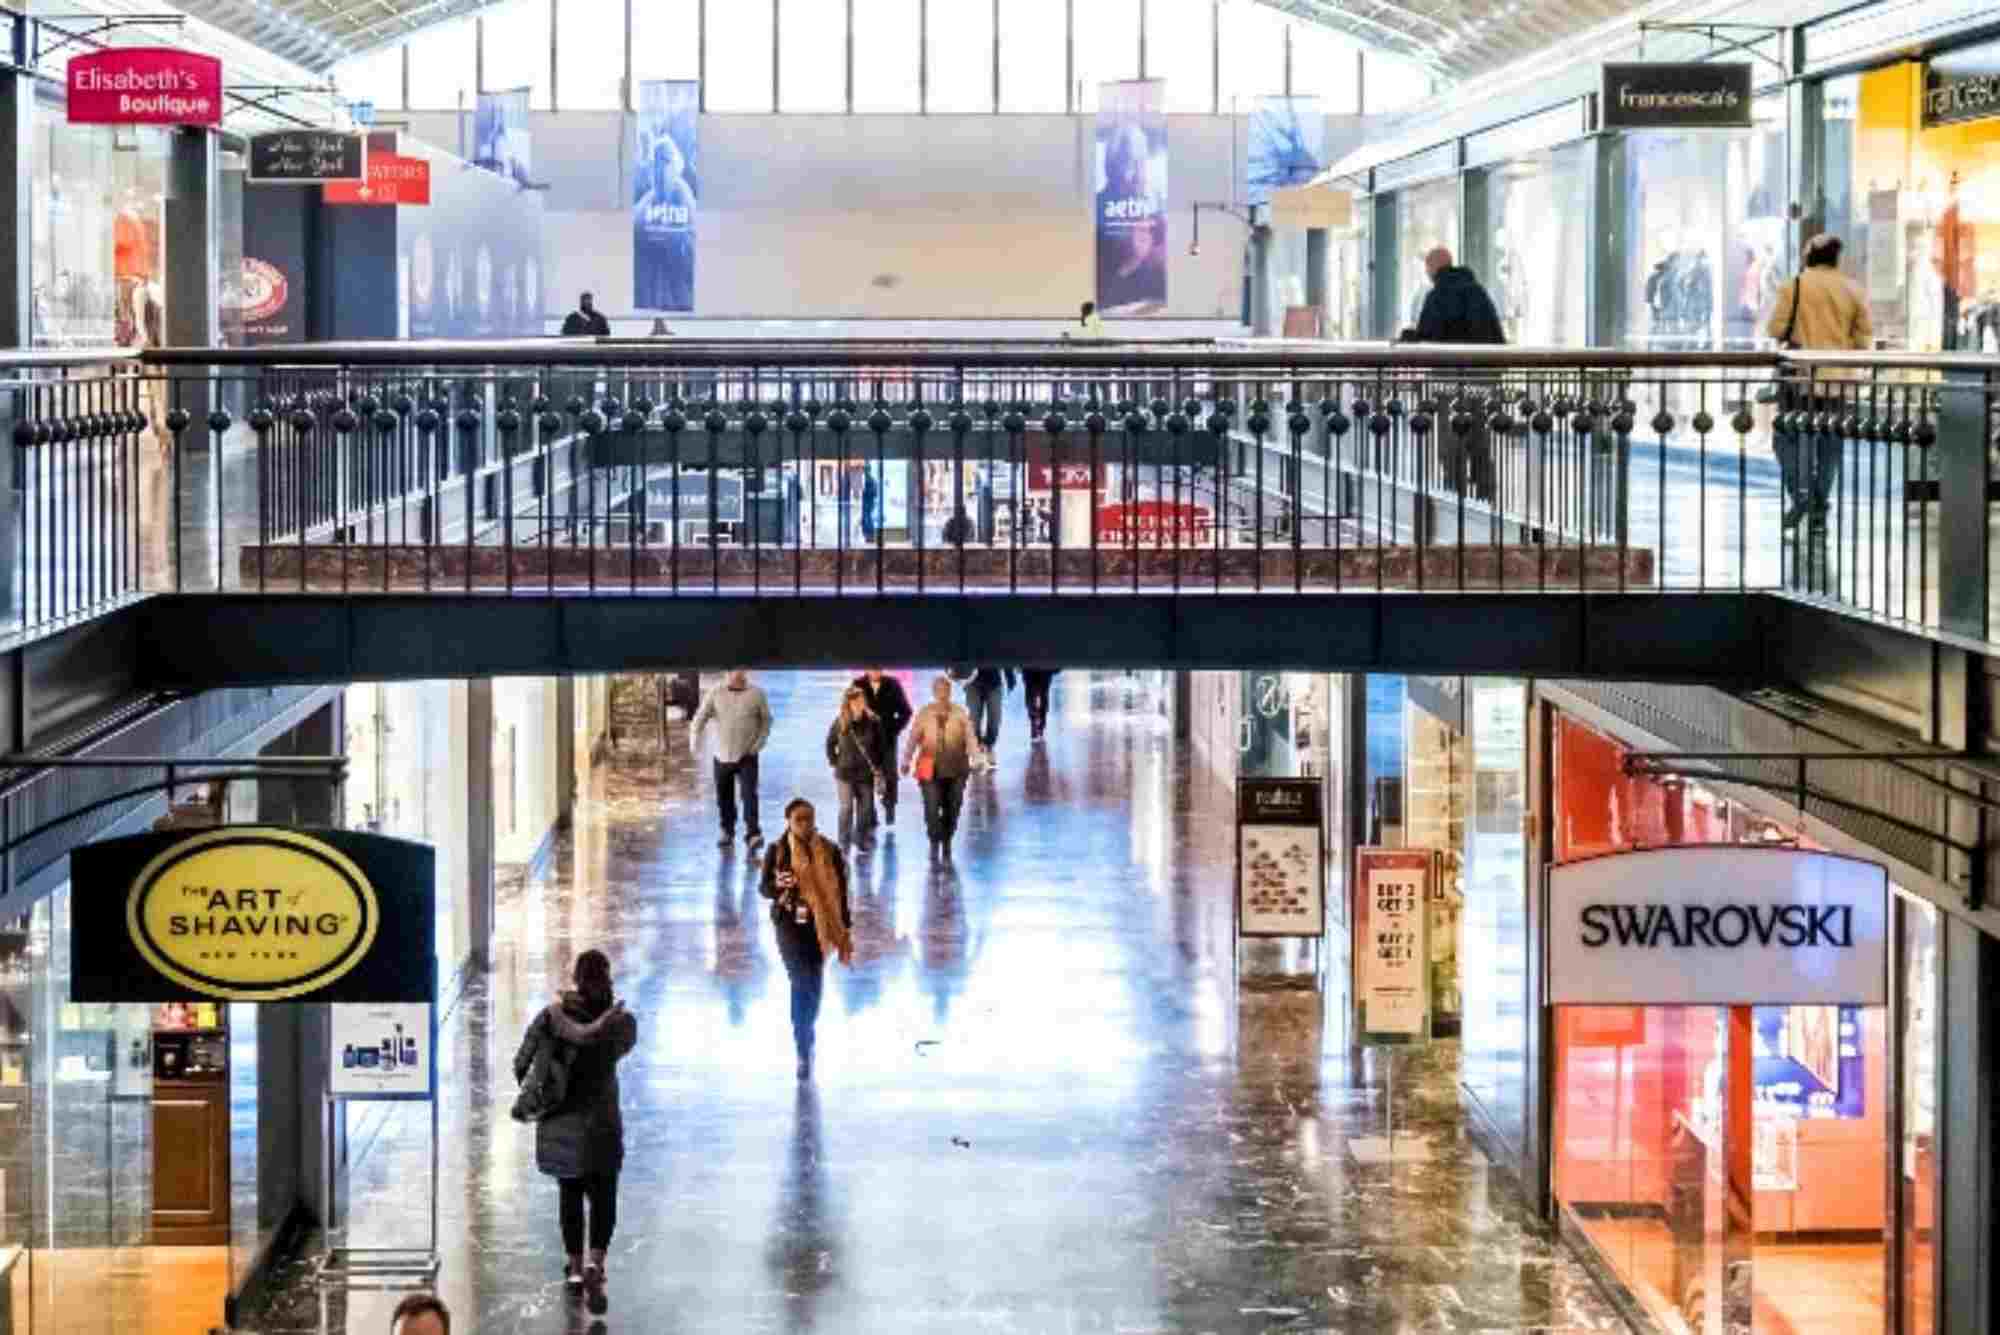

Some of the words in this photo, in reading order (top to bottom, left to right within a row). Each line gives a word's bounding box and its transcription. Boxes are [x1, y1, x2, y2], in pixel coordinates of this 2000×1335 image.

[75, 65, 199, 91] Elisabeth's
[119, 94, 210, 117] Boutique
[1620, 82, 1738, 108] francesca's
[207, 889, 281, 912] ART
[169, 913, 340, 937] SHAVING
[1580, 903, 1854, 948] SWAROVSKI
